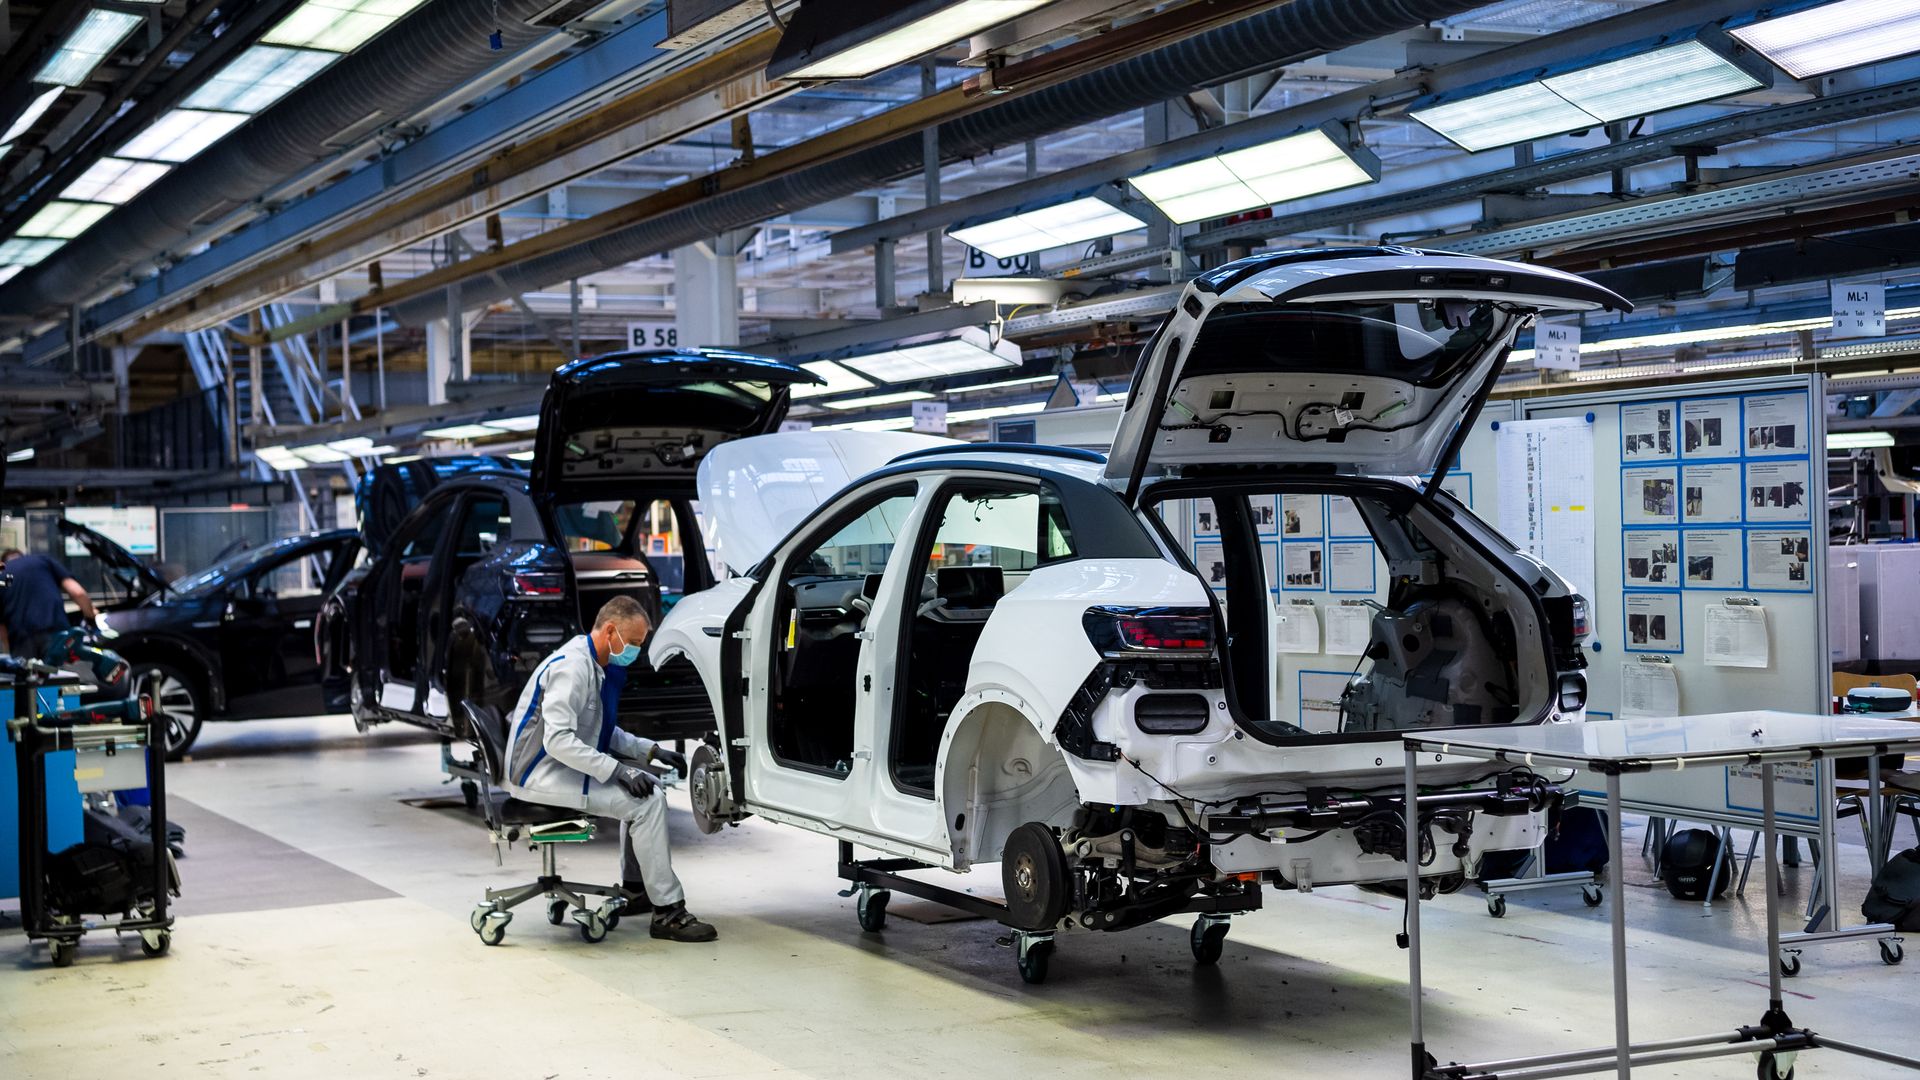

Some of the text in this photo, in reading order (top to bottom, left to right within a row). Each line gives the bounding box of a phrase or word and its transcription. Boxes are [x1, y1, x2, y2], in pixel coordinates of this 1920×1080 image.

[970, 247, 985, 269] B
[1847, 291, 1868, 302] ML-1
[633, 328, 677, 347] B 58
[1548, 330, 1567, 340] ML-1
